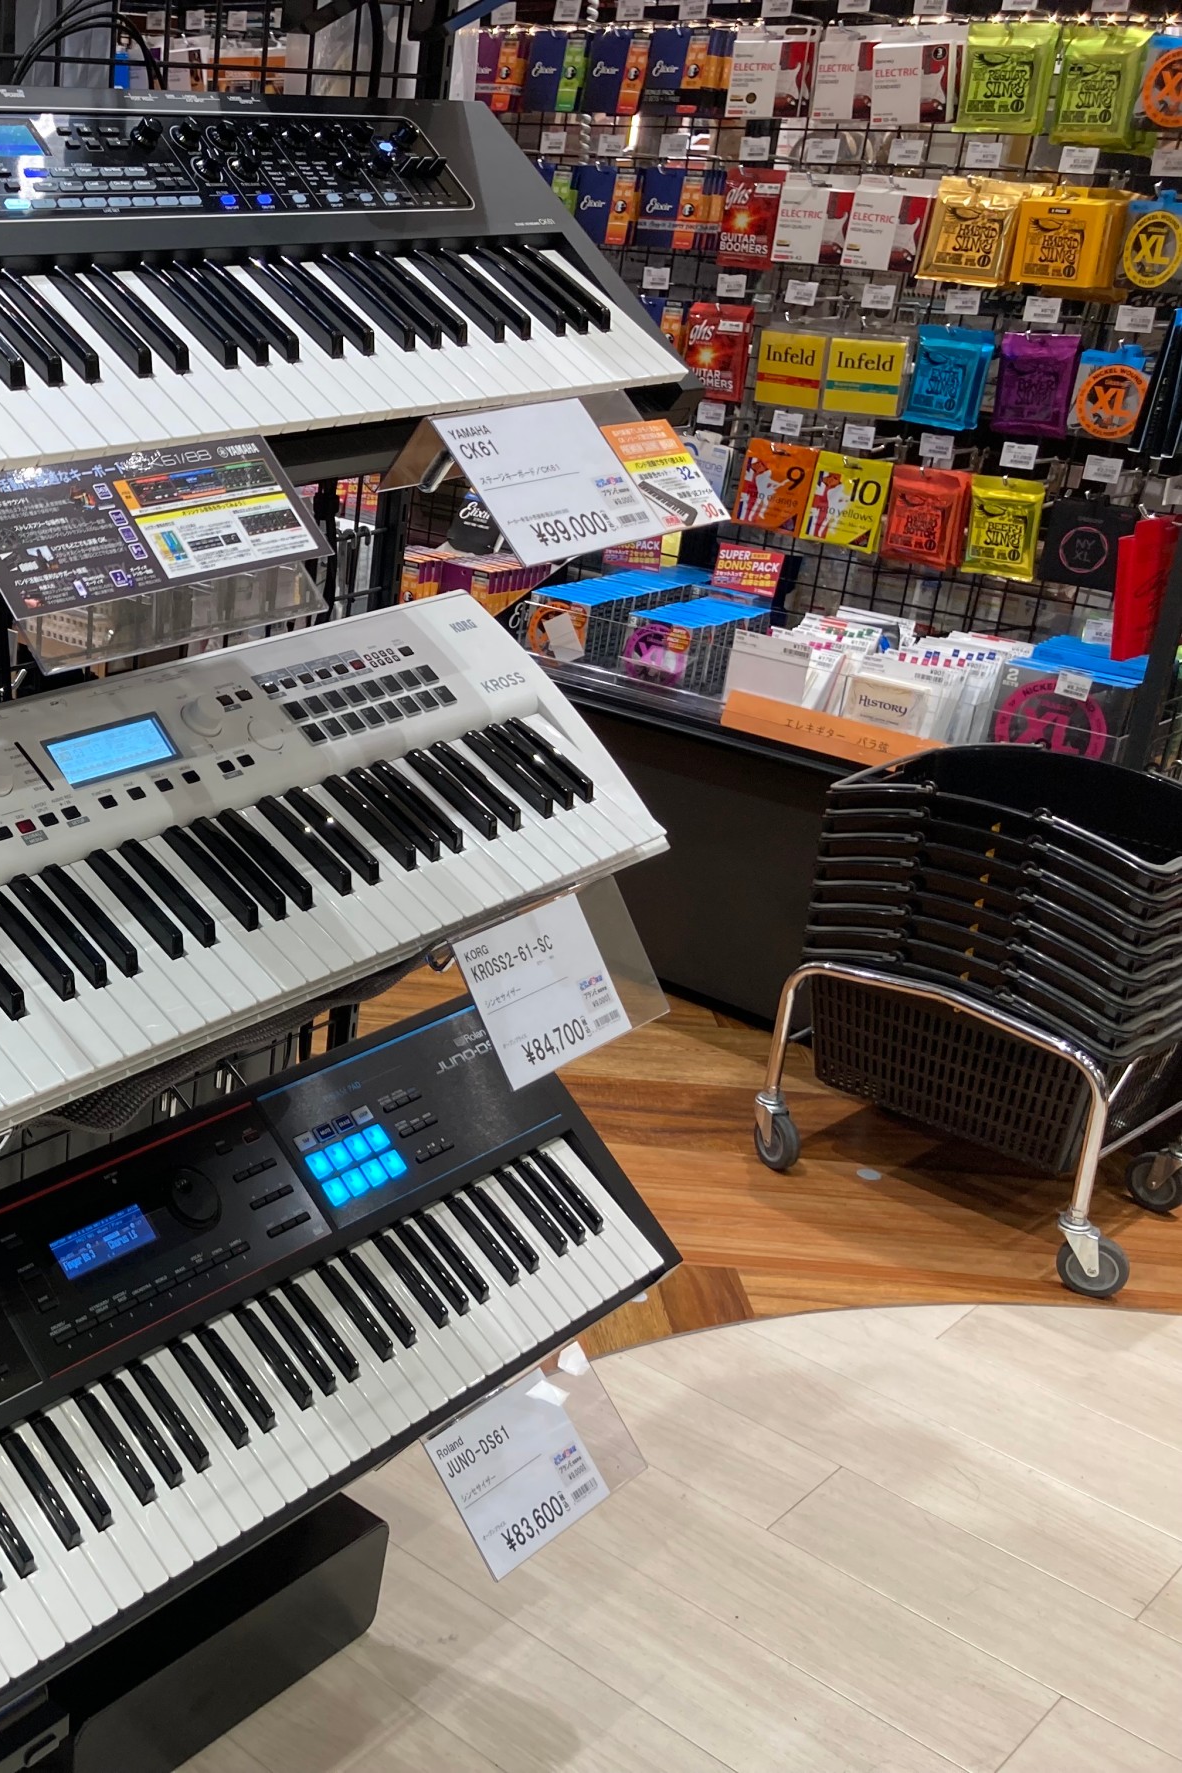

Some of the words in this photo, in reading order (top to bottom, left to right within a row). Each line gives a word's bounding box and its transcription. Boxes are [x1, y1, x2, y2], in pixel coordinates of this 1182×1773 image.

[531, 61, 557, 78] Elixir
[592, 61, 619, 78] Elixir
[652, 60, 679, 77] Elixir
[734, 62, 777, 72] ELECTRIC
[818, 63, 855, 73] ELECTRIC
[875, 67, 919, 78] ELECTRIC
[988, 69, 1029, 82] REGULAR
[983, 81, 1026, 99] SLINKY
[1080, 79, 1116, 92] REGULAR
[1075, 91, 1114, 109] SLINKY
[580, 195, 606, 210] Elixir
[724, 183, 752, 210] ghs
[645, 198, 673, 214] Elixir
[781, 209, 823, 219] ELECTRIC
[853, 211, 895, 224] ELECTRIC
[720, 232, 757, 243] GUITAR
[956, 224, 999, 238] HYBRID
[719, 241, 768, 255] BOOMERS
[952, 236, 996, 254] SLINKY
[1042, 235, 1079, 249] HYBRID
[1134, 233, 1170, 265] XL
[1038, 247, 1079, 266] SLINKY
[689, 319, 716, 346] ghs
[766, 344, 816, 367] Infeld
[836, 351, 895, 372] Infeld
[693, 367, 721, 379] UITAR
[1092, 366, 1119, 381] NICKEL
[1120, 367, 1143, 385] WOUND
[700, 377, 733, 392] OMERS
[1090, 386, 1132, 418] XL
[448, 425, 492, 440] YAMAHA
[227, 442, 260, 457] YAMAHA
[459, 440, 500, 460] CK61
[676, 466, 696, 481] 32
[786, 466, 806, 491] 9
[849, 478, 882, 506] 10
[701, 503, 719, 518] 30
[838, 507, 874, 524] yellows
[530, 511, 608, 546] ¥99,000
[986, 522, 1023, 534] BEEFY
[984, 531, 1022, 549] SLINKY
[1075, 538, 1095, 549] NY
[719, 550, 751, 561] SUPER
[1073, 551, 1091, 563] XL
[449, 618, 478, 633] KORG
[480, 671, 526, 694] KROSS
[1006, 668, 1019, 681] 2
[1022, 682, 1056, 697] NICKE
[858, 695, 908, 717] HISTORY
[785, 718, 845, 739] エレキギター
[857, 738, 890, 754] バラ弦
[463, 944, 489, 963] KORG
[470, 934, 553, 983] KROSS2-61-SC
[484, 987, 522, 1009] シンセサイザー
[464, 1028, 487, 1043] Rolan
[521, 1018, 585, 1065] ¥84,700
[436, 1436, 464, 1460] Roland
[447, 1424, 510, 1479] JUNO-DS61
[461, 1474, 496, 1503] シンセサイザー
[501, 1495, 564, 1552] ¥83,600
